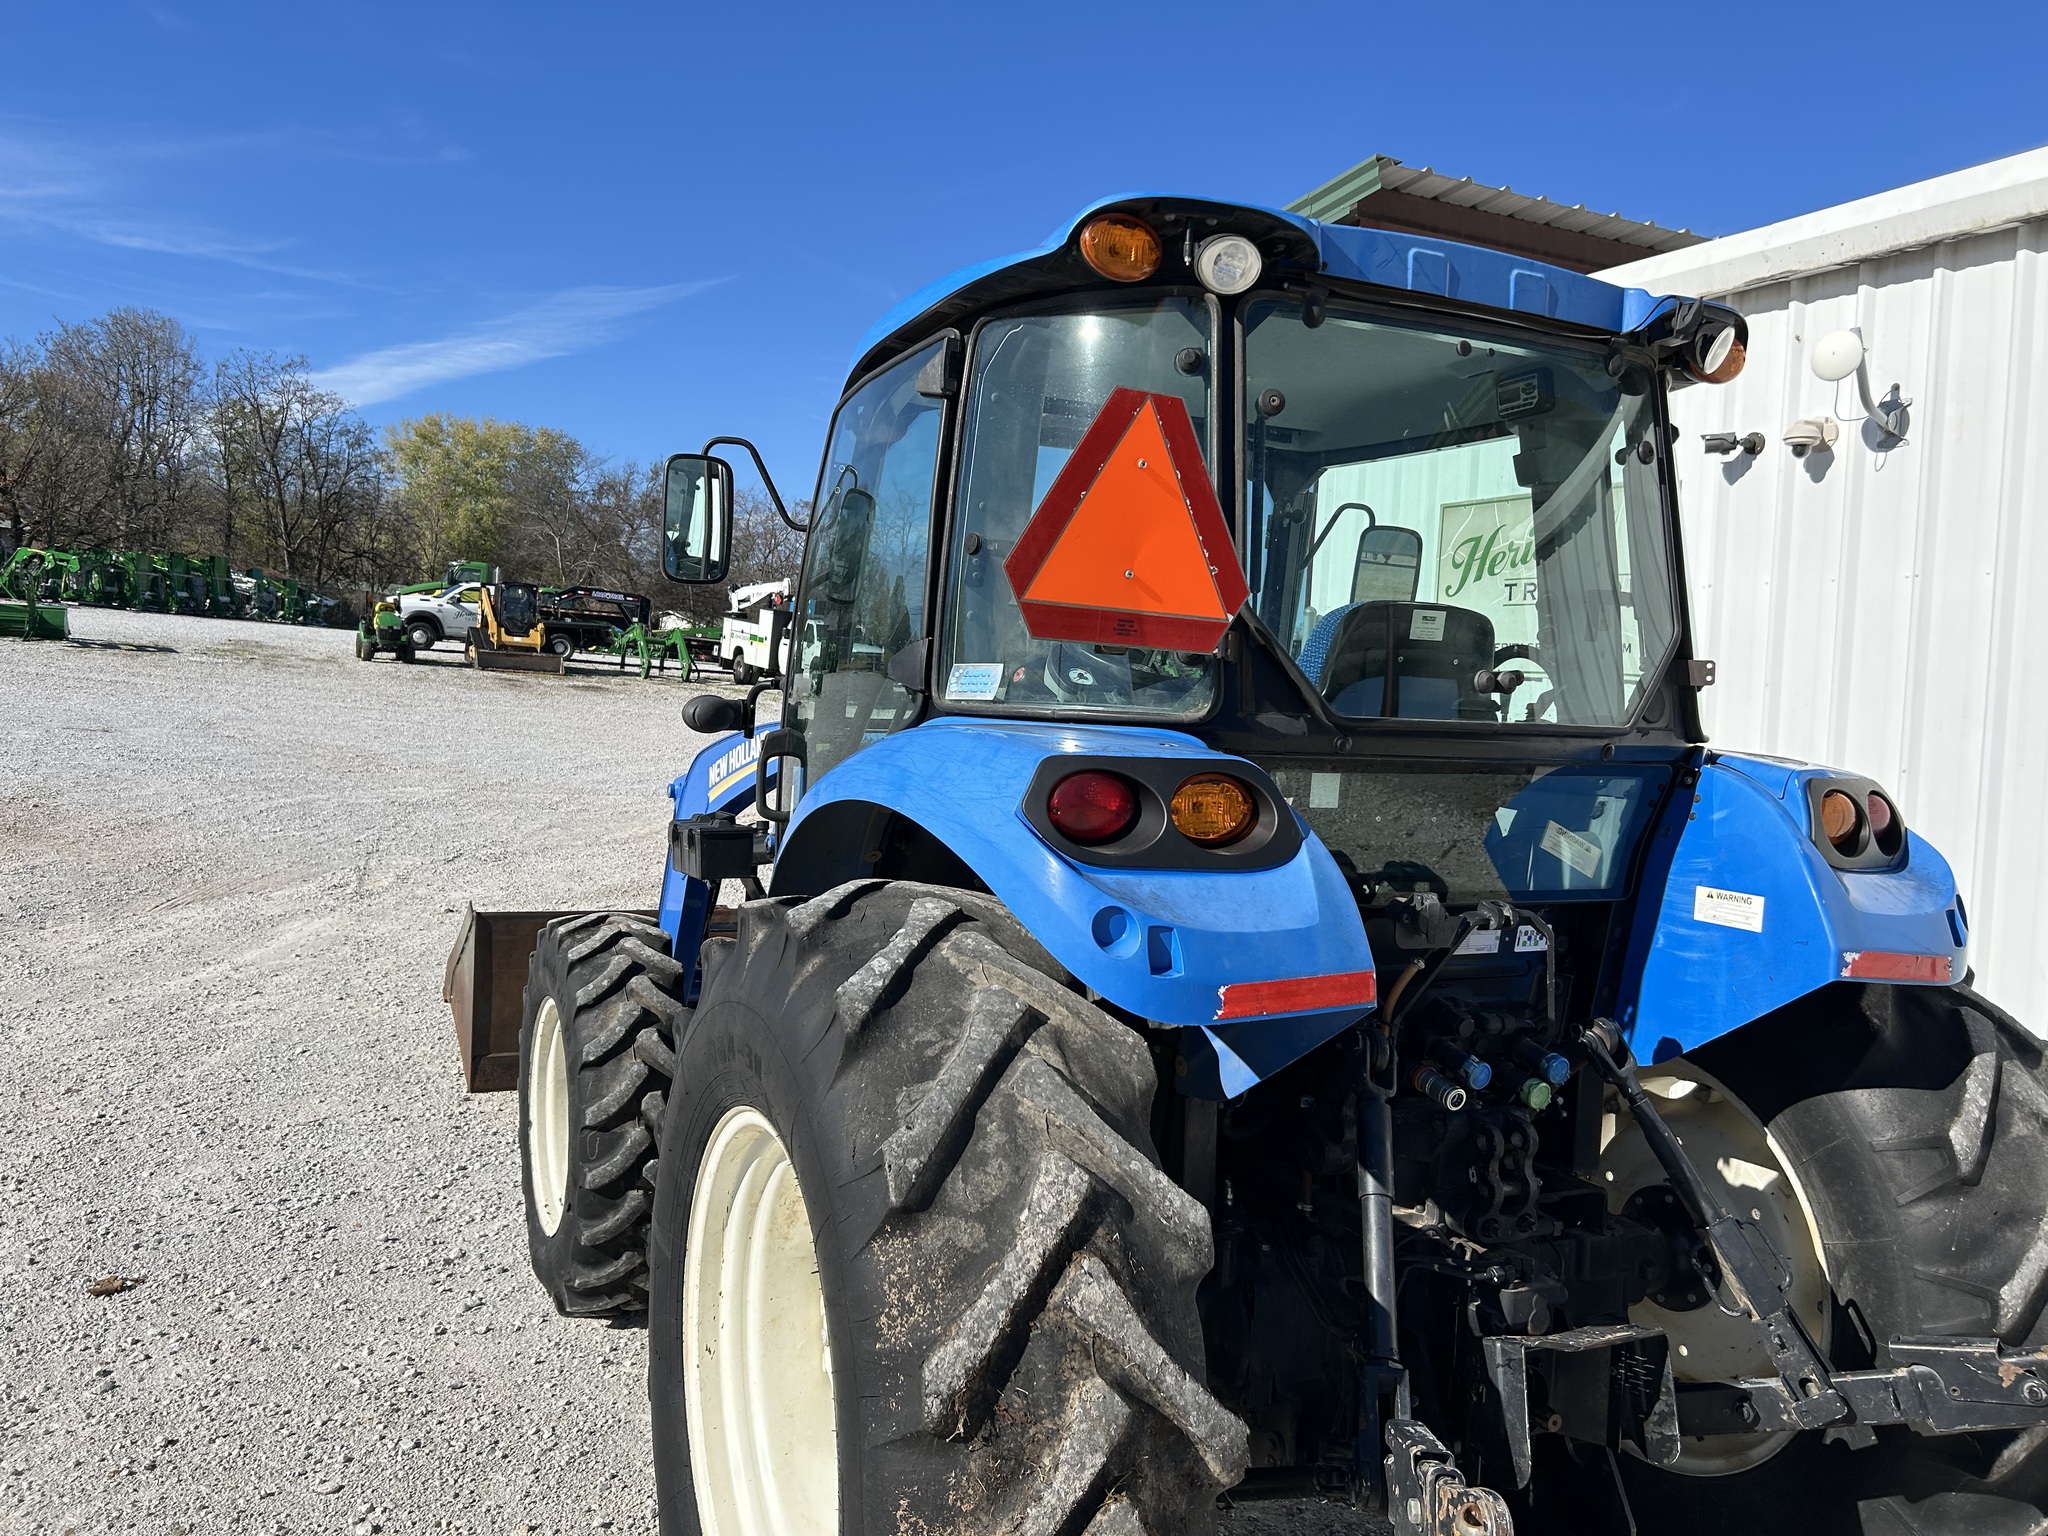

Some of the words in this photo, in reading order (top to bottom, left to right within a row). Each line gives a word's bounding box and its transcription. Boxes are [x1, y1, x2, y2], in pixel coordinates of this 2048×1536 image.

[1445, 523, 1536, 598] Heri
[1504, 582, 1537, 602] TR
[708, 753, 729, 789] NEW
[1716, 891, 1753, 906] WARNING
